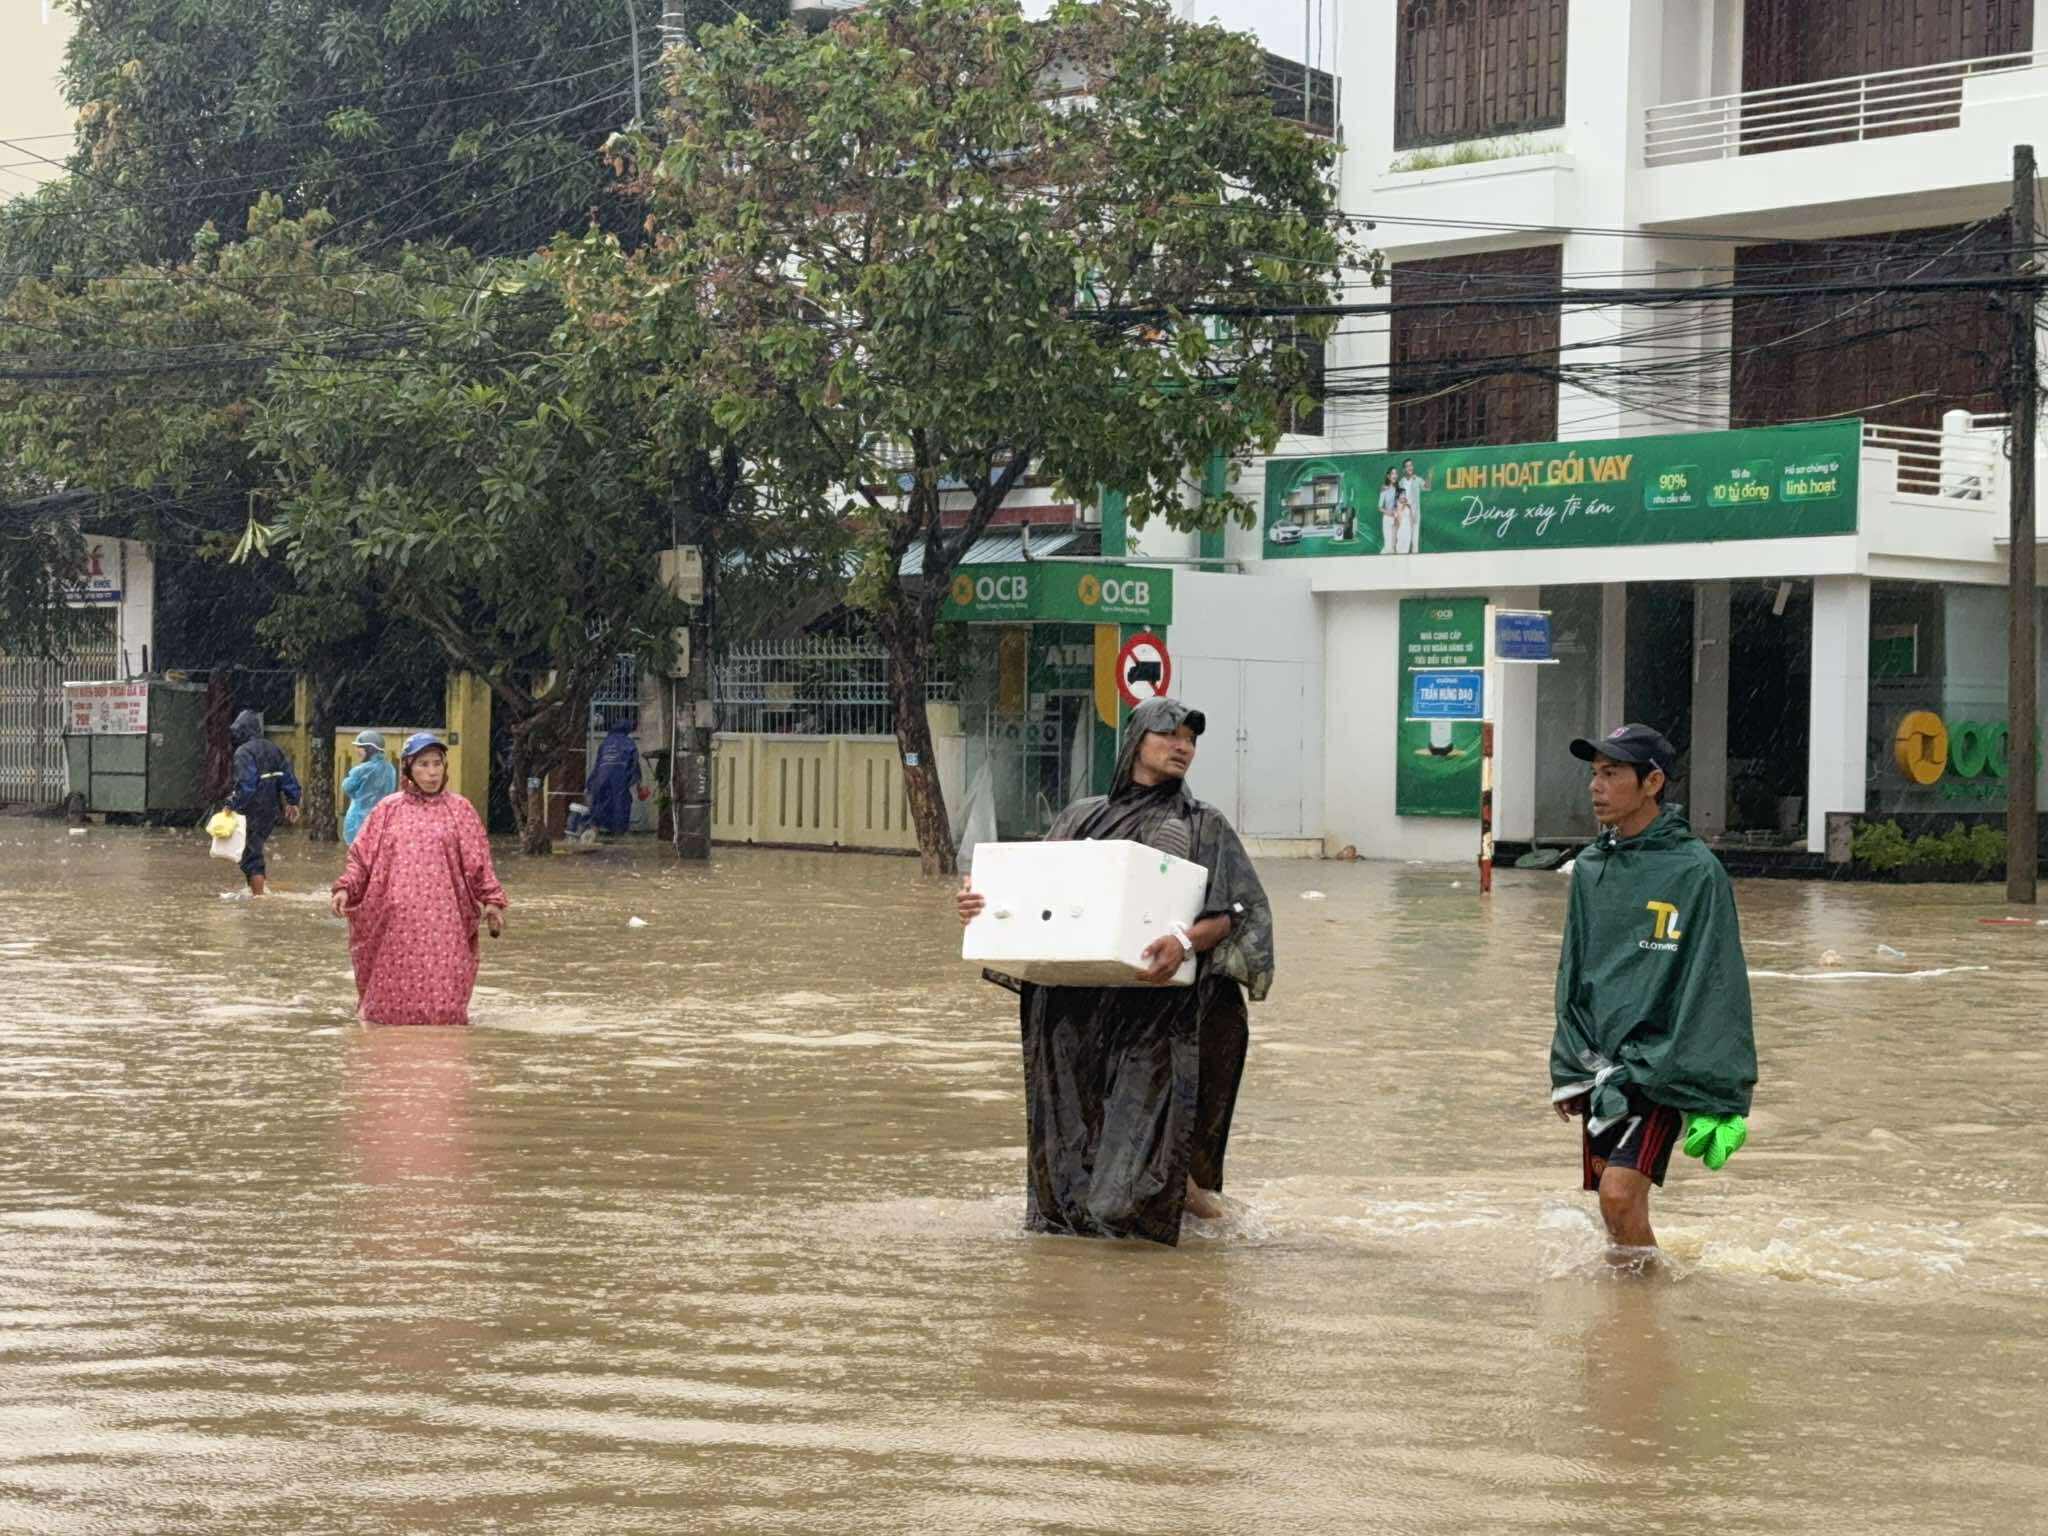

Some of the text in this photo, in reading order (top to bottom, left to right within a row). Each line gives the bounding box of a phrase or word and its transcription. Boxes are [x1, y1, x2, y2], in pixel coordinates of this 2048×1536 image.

[1446, 450, 1633, 493] LINH HOẠT GÓI VAY
[1659, 473, 1687, 490] 90%
[1713, 484, 1726, 499] 10
[975, 575, 1029, 602] OCB
[1101, 579, 1150, 605] OCB
[1646, 901, 1681, 940] TL
[1638, 940, 1679, 952] CLOTHING
